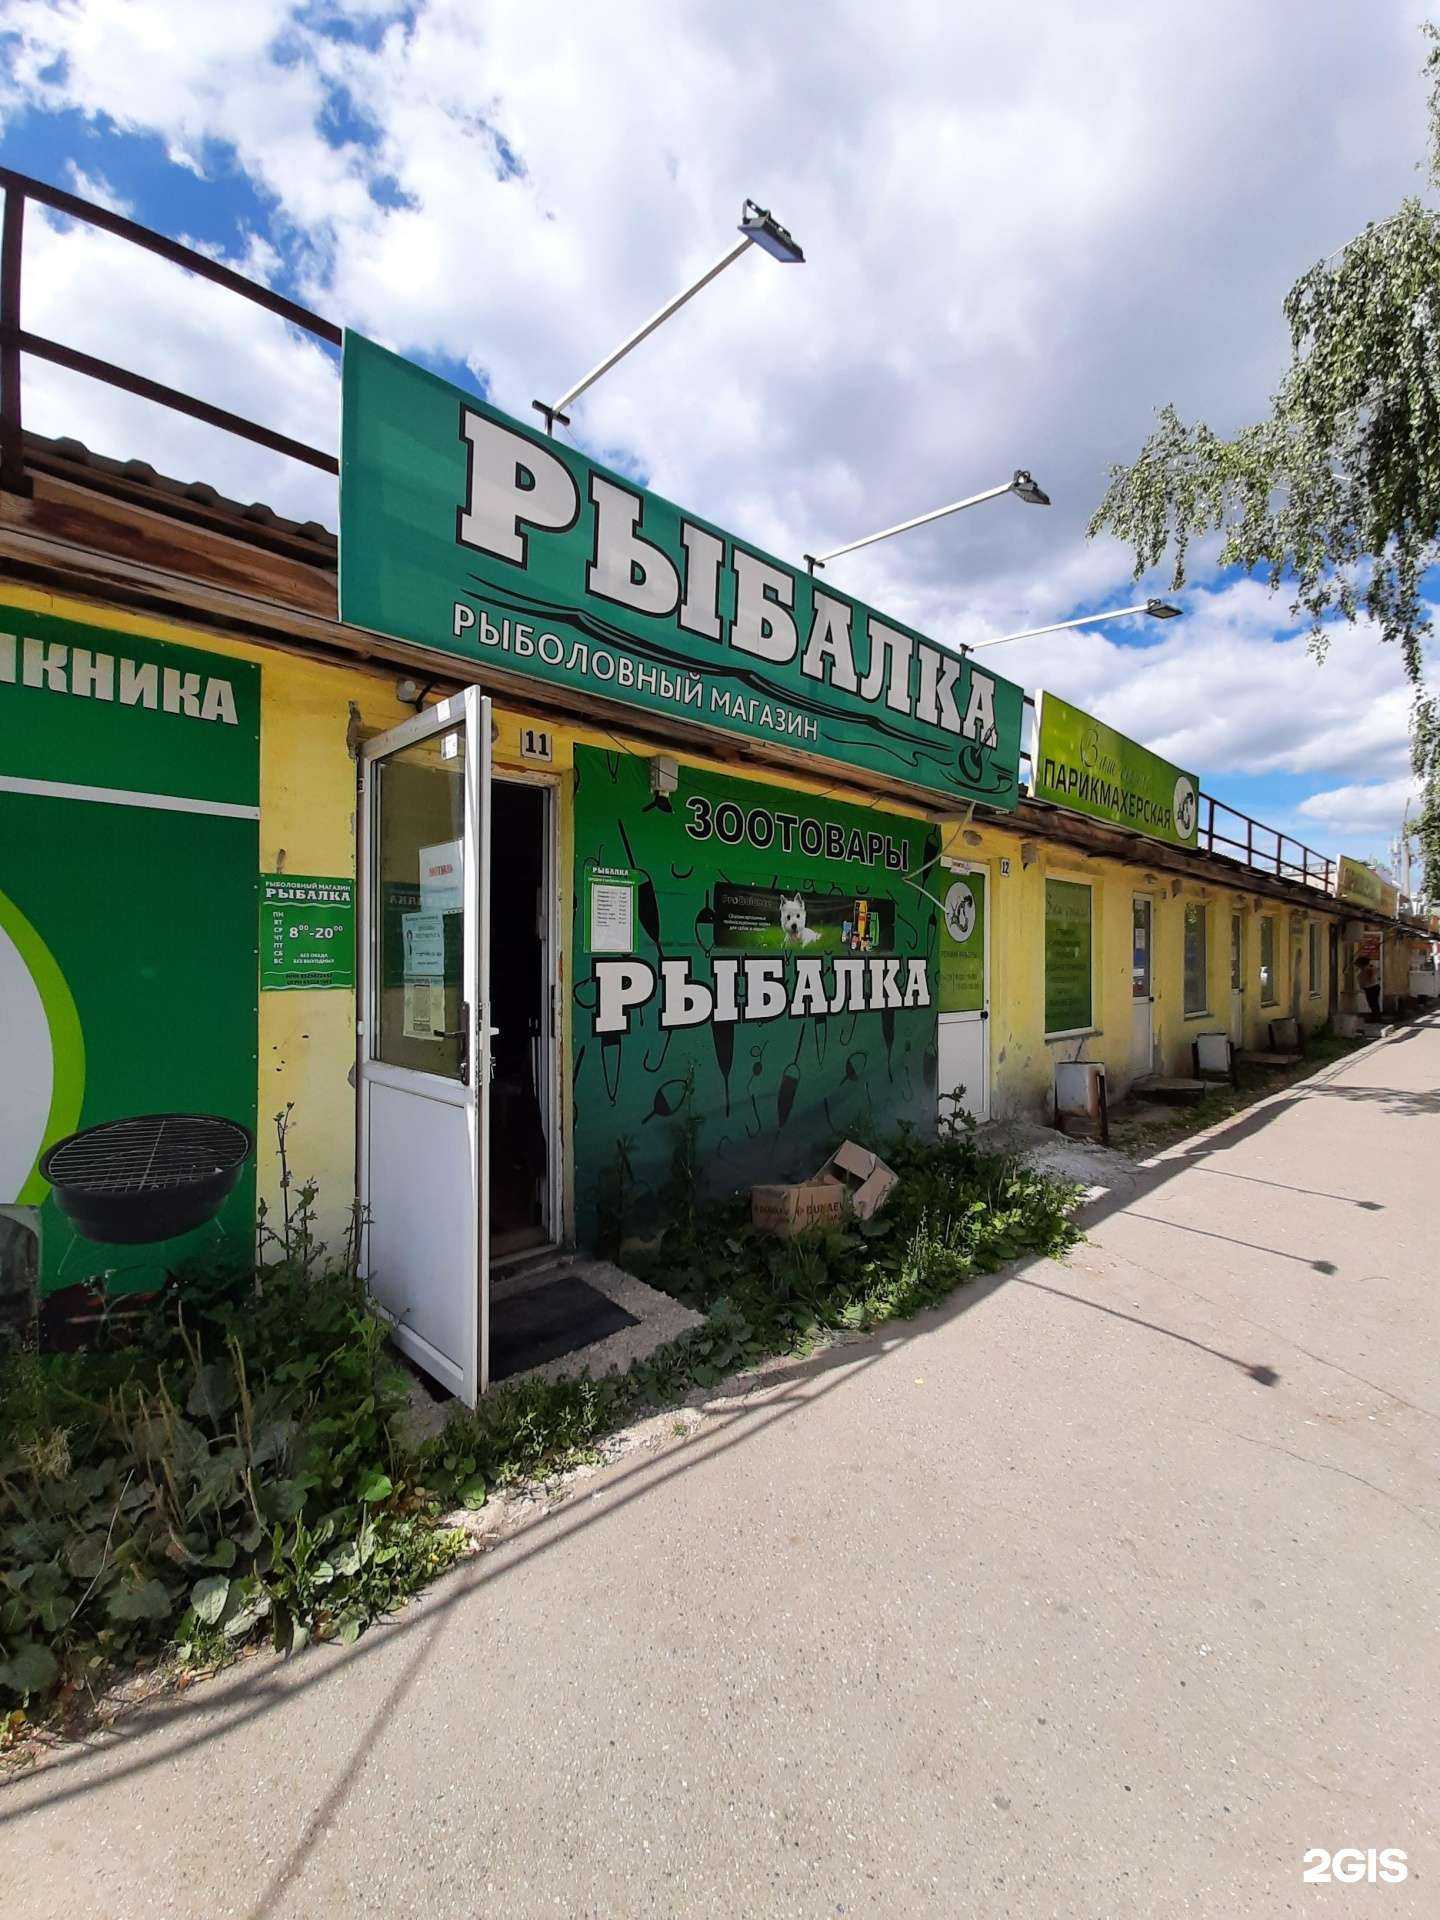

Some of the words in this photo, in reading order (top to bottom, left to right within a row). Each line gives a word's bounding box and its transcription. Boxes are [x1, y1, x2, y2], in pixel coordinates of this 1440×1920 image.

[456, 402, 998, 749] РЫБАЛКА
[452, 600, 704, 708] РЫБОЛОВНЫЙ
[709, 686, 819, 743] МАГАЗИН
[525, 730, 549, 756] 11
[1043, 758, 1171, 830] ПАРИКМАХЕРСКАЯ
[685, 796, 910, 872] ЗООТОВАРЫ
[265, 881, 317, 889] РЫБОЛОВНЫЙ
[592, 866, 629, 876] РЫБАЛКА
[1002, 861, 1010, 874] 12
[265, 888, 351, 901] РЫБАЛКА
[593, 956, 932, 1034] РЫБАЛКА
